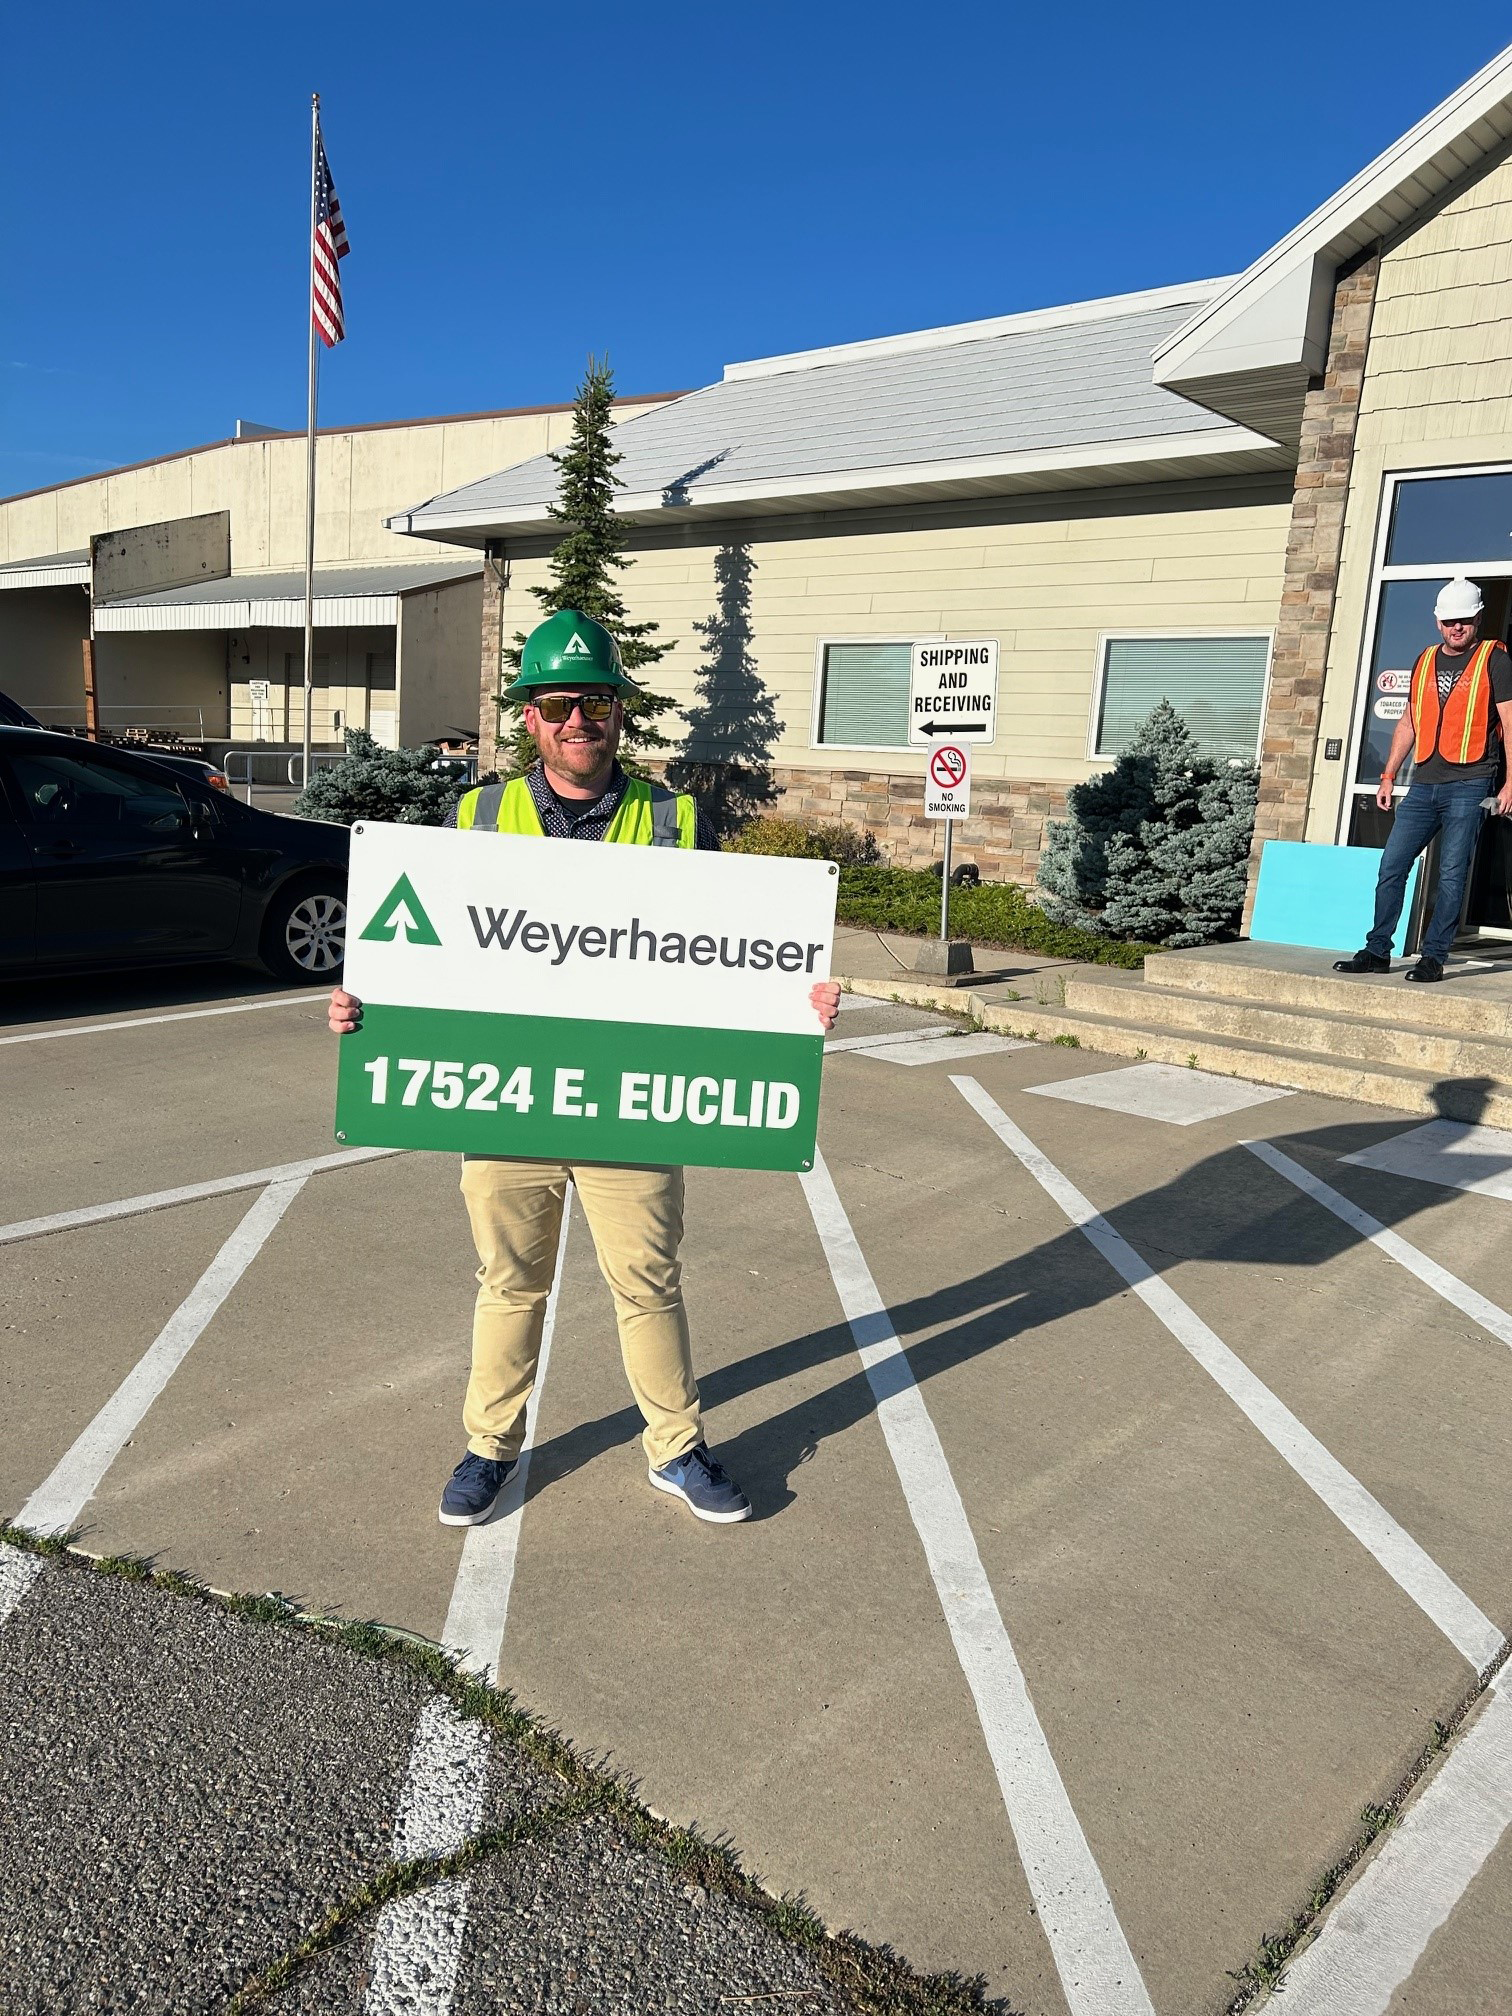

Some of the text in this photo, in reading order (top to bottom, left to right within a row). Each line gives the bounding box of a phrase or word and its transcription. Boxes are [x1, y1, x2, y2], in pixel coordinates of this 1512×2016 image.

[920, 648, 989, 667] SHIPPING
[938, 672, 968, 689] AND
[914, 695, 991, 713] RECEIVING
[941, 792, 954, 801] NO
[928, 803, 966, 813] SMOKING
[466, 905, 824, 974] Weyerhaeuser
[364, 1056, 801, 1130] 17524 E. EUCLID
